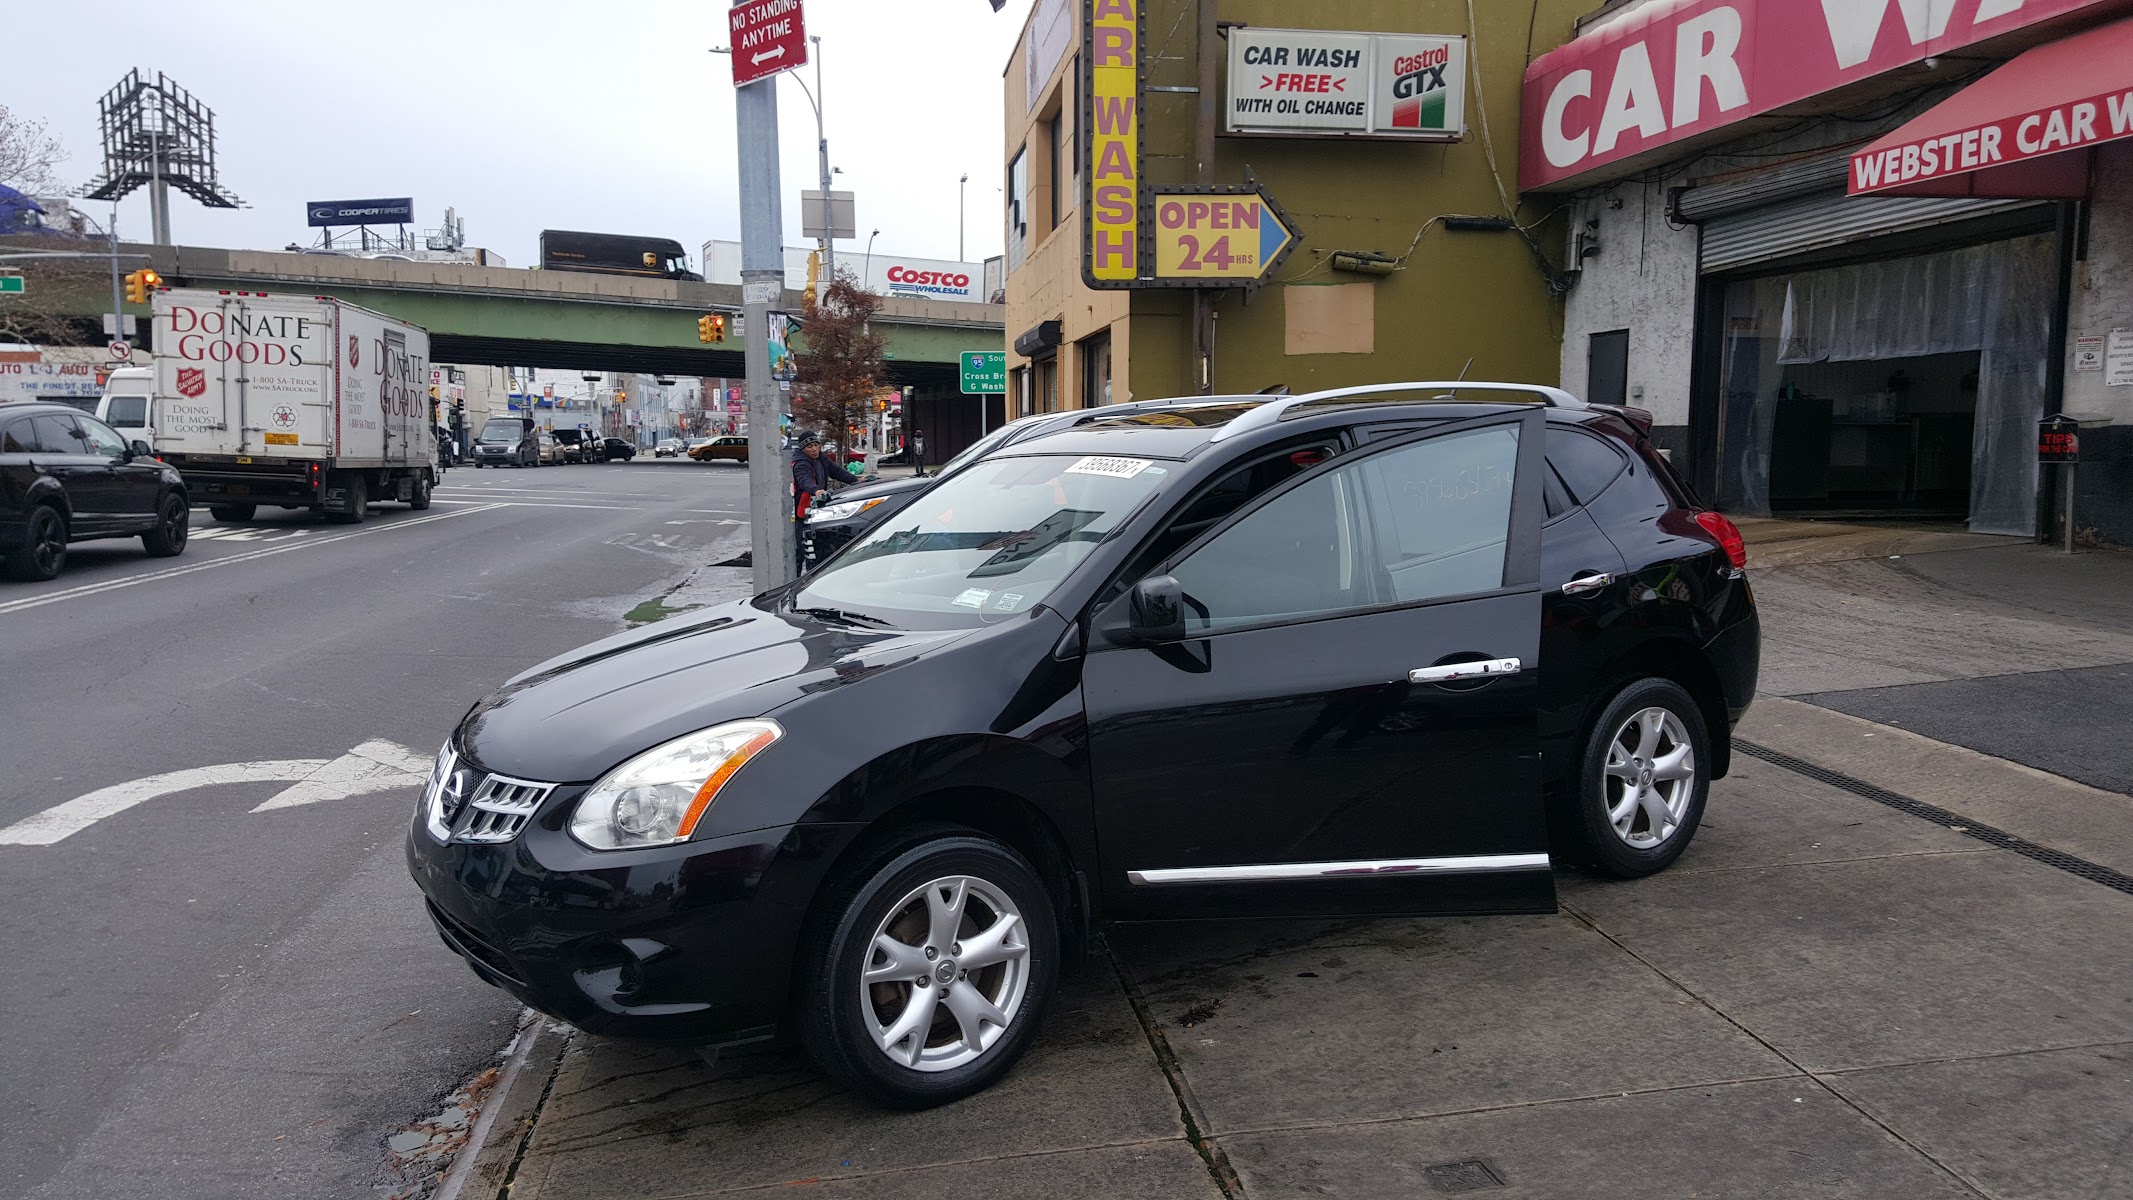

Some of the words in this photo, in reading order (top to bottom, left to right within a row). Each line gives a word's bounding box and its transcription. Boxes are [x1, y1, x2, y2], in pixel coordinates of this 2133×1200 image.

[732, 13, 746, 31] NO
[749, 0, 798, 25] STANDING
[741, 18, 792, 49] ANYTIME
[1244, 46, 1290, 65] CAR
[1297, 48, 1361, 69] WASH
[1394, 43, 1449, 76] Castrol
[1392, 62, 1448, 99] GTX
[1541, 6, 1750, 169] CAR
[1235, 98, 1273, 113] WITH
[1276, 99, 1300, 114] OIL
[1304, 101, 1365, 115] CHANGE
[1854, 125, 2003, 190] WEBSTER
[2016, 102, 2097, 154] CAR
[1094, 96, 1135, 269] WASH
[1159, 202, 1259, 229] OPEN
[1177, 234, 1235, 270] 24
[1236, 254, 1254, 264] HRS
[887, 265, 970, 288] COSTCO
[915, 285, 969, 295] WHOLESALE
[972, 359, 984, 367] 95
[43, 382, 76, 390] FINEST
[252, 376, 274, 384] 1-800
[2043, 433, 2073, 444] TIPS
